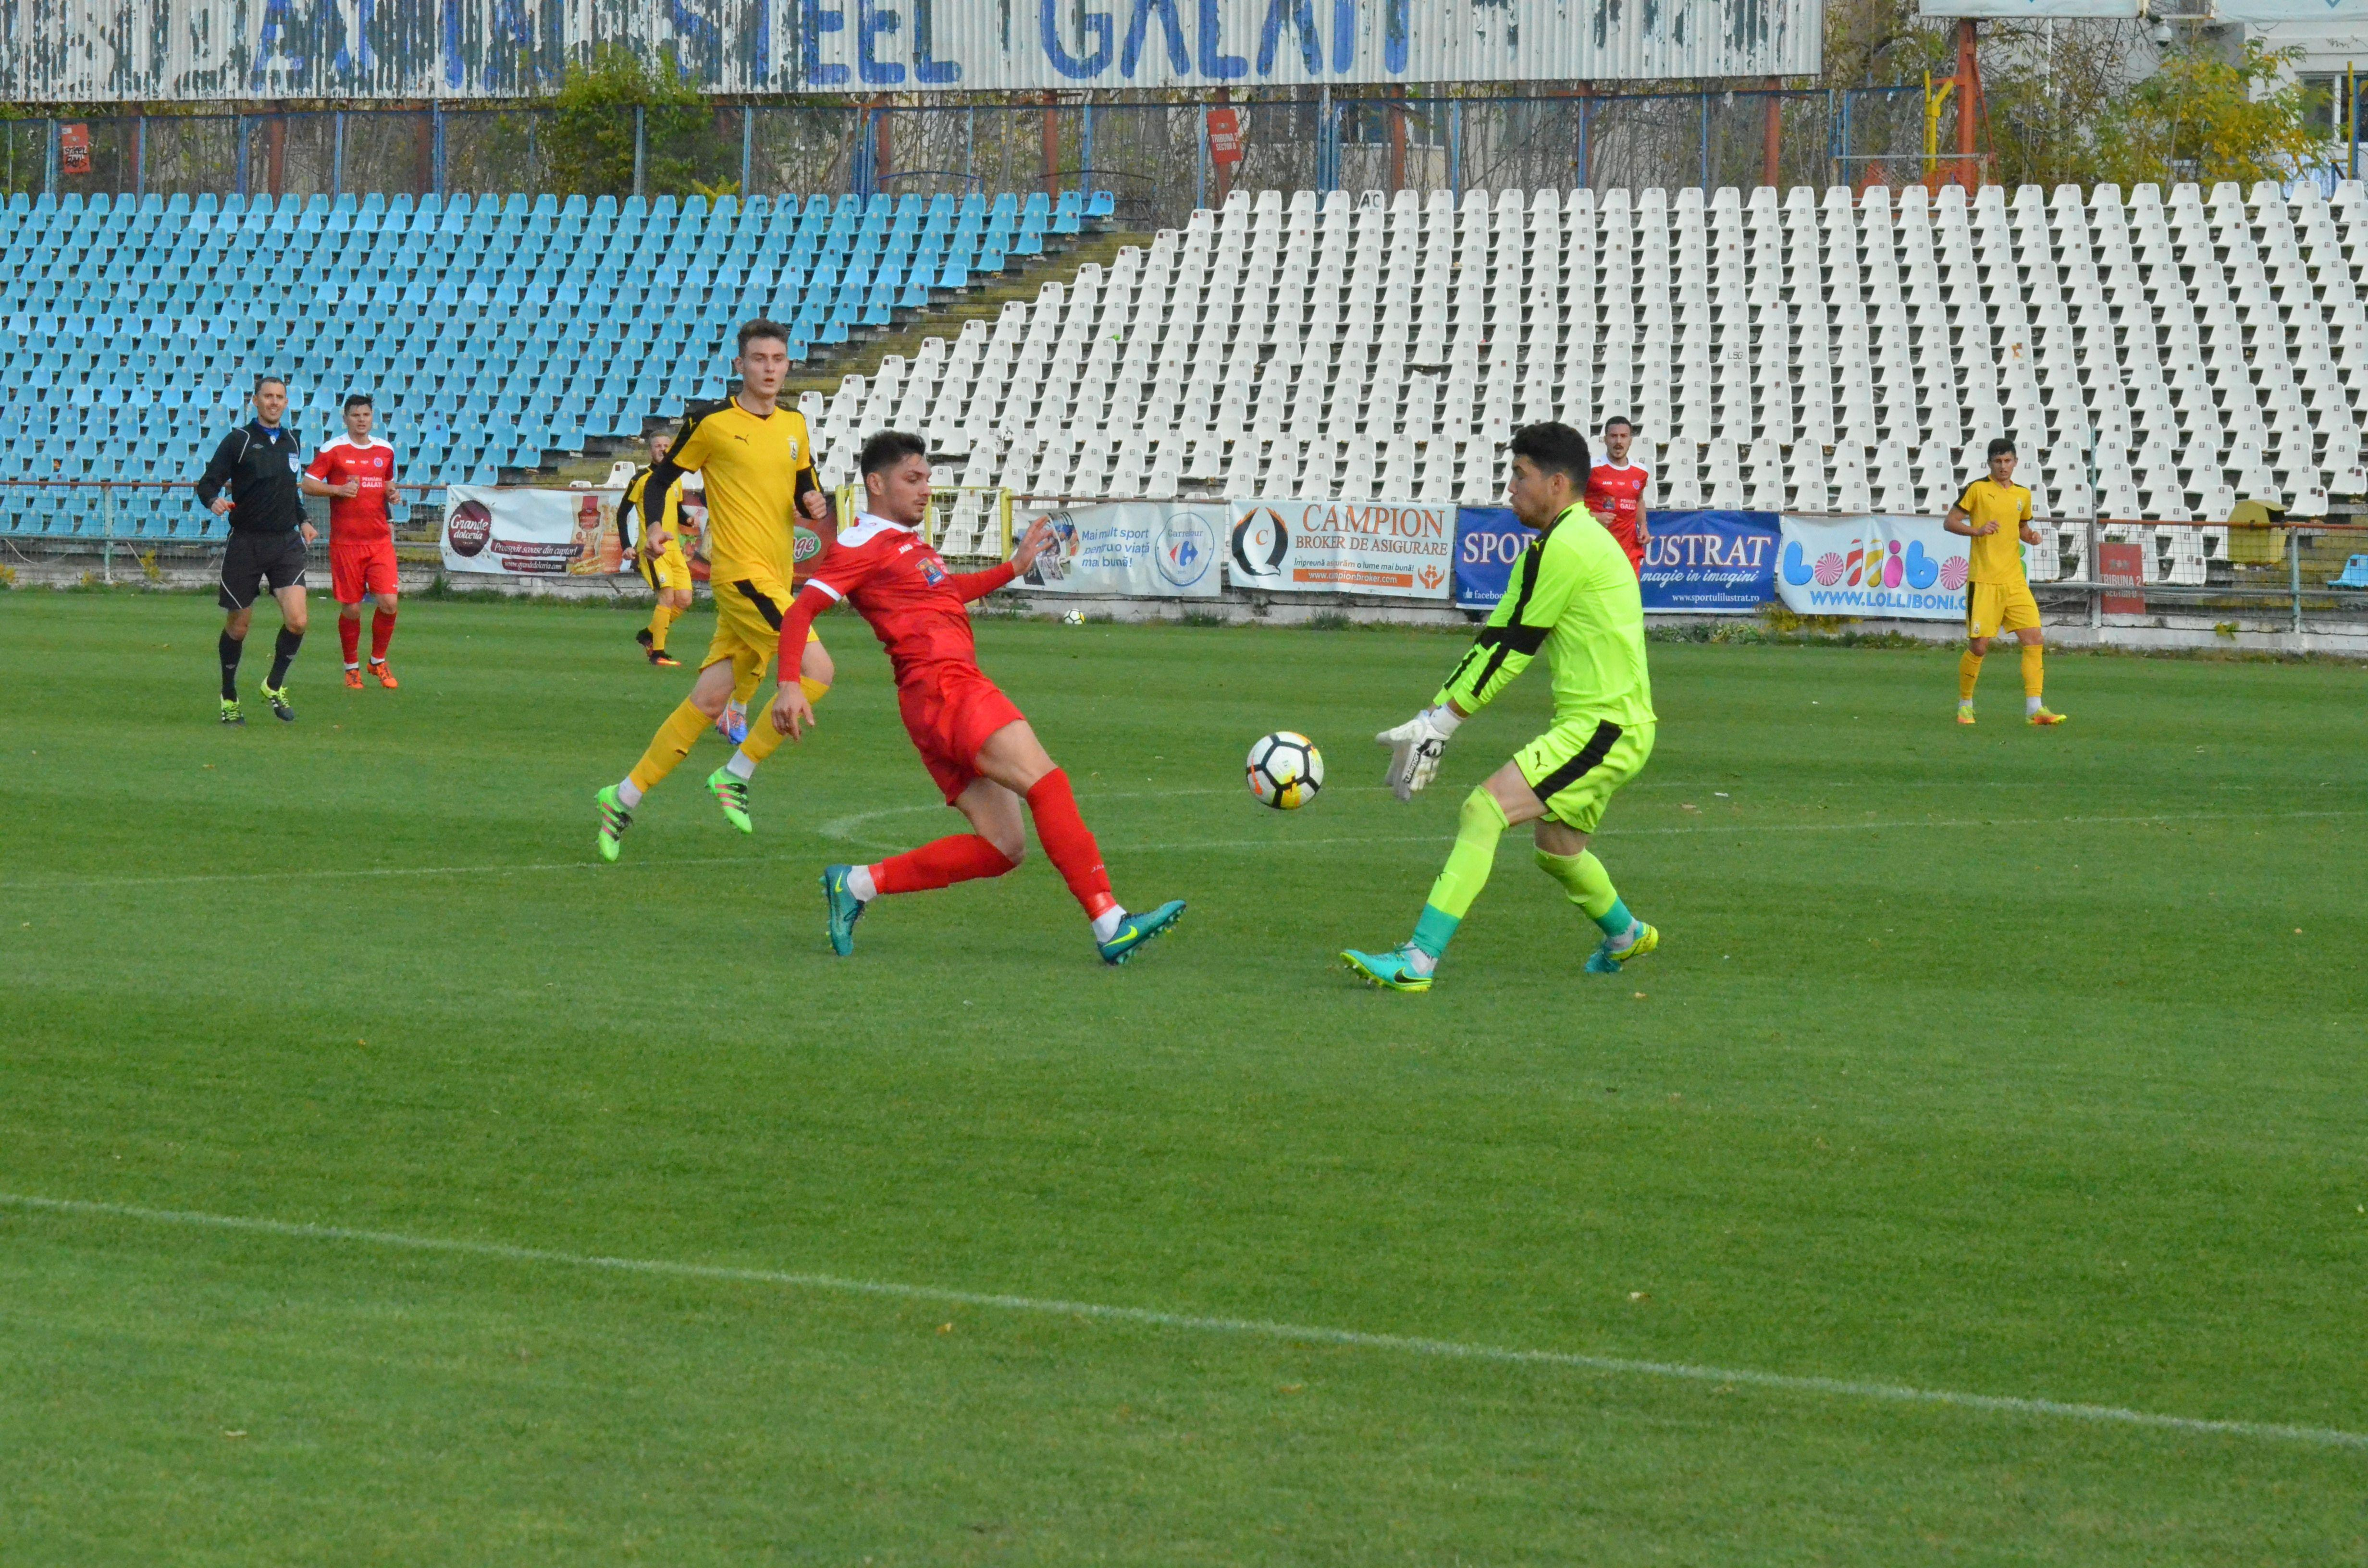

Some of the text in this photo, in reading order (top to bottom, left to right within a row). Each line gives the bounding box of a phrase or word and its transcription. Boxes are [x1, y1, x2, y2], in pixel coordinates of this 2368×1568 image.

[1211, 133, 1239, 143] TRIBUNA 2
[450, 514, 489, 531] Grande
[1303, 503, 1445, 539] CAMPION
[454, 530, 483, 540] dolceria
[1082, 529, 1098, 540] Mai
[1120, 529, 1149, 540] sport
[1255, 529, 1269, 545] C
[543, 545, 553, 554] din
[1083, 543, 1113, 555] pentru
[1295, 536, 1448, 556] BROKER DE ASIGURARE
[1640, 535, 1771, 566] USTRAT
[1363, 562, 1379, 570] lume
[1640, 569, 1760, 588] magie in imagini
[2136, 576, 2142, 586] 2
[1475, 590, 1506, 600] faceboo
[1672, 592, 1760, 603] www.sportulilustrat.ro
